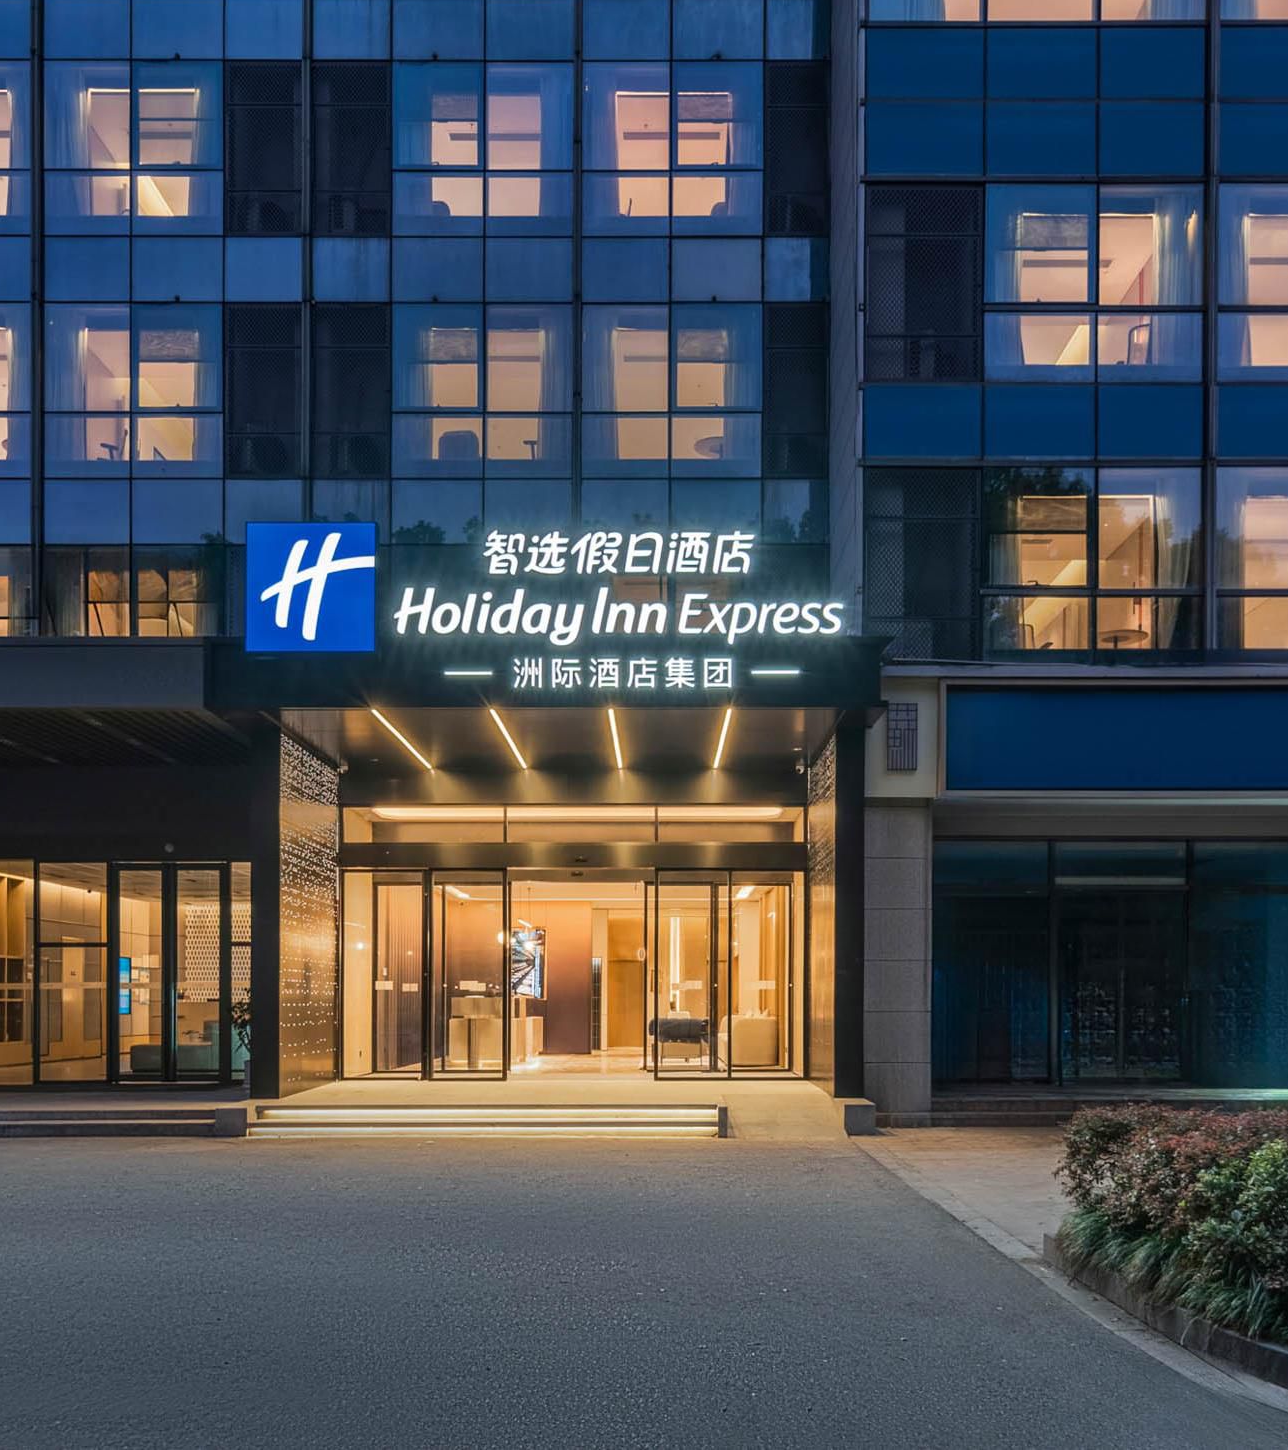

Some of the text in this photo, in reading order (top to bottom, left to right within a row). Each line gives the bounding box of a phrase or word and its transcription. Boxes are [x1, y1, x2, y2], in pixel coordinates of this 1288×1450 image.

[483, 529, 756, 576] 智选假日酒店
[393, 587, 584, 646] Holiday
[591, 586, 667, 634] Inn
[678, 593, 845, 645] Express
[513, 656, 733, 689] 洲际酒店集团
